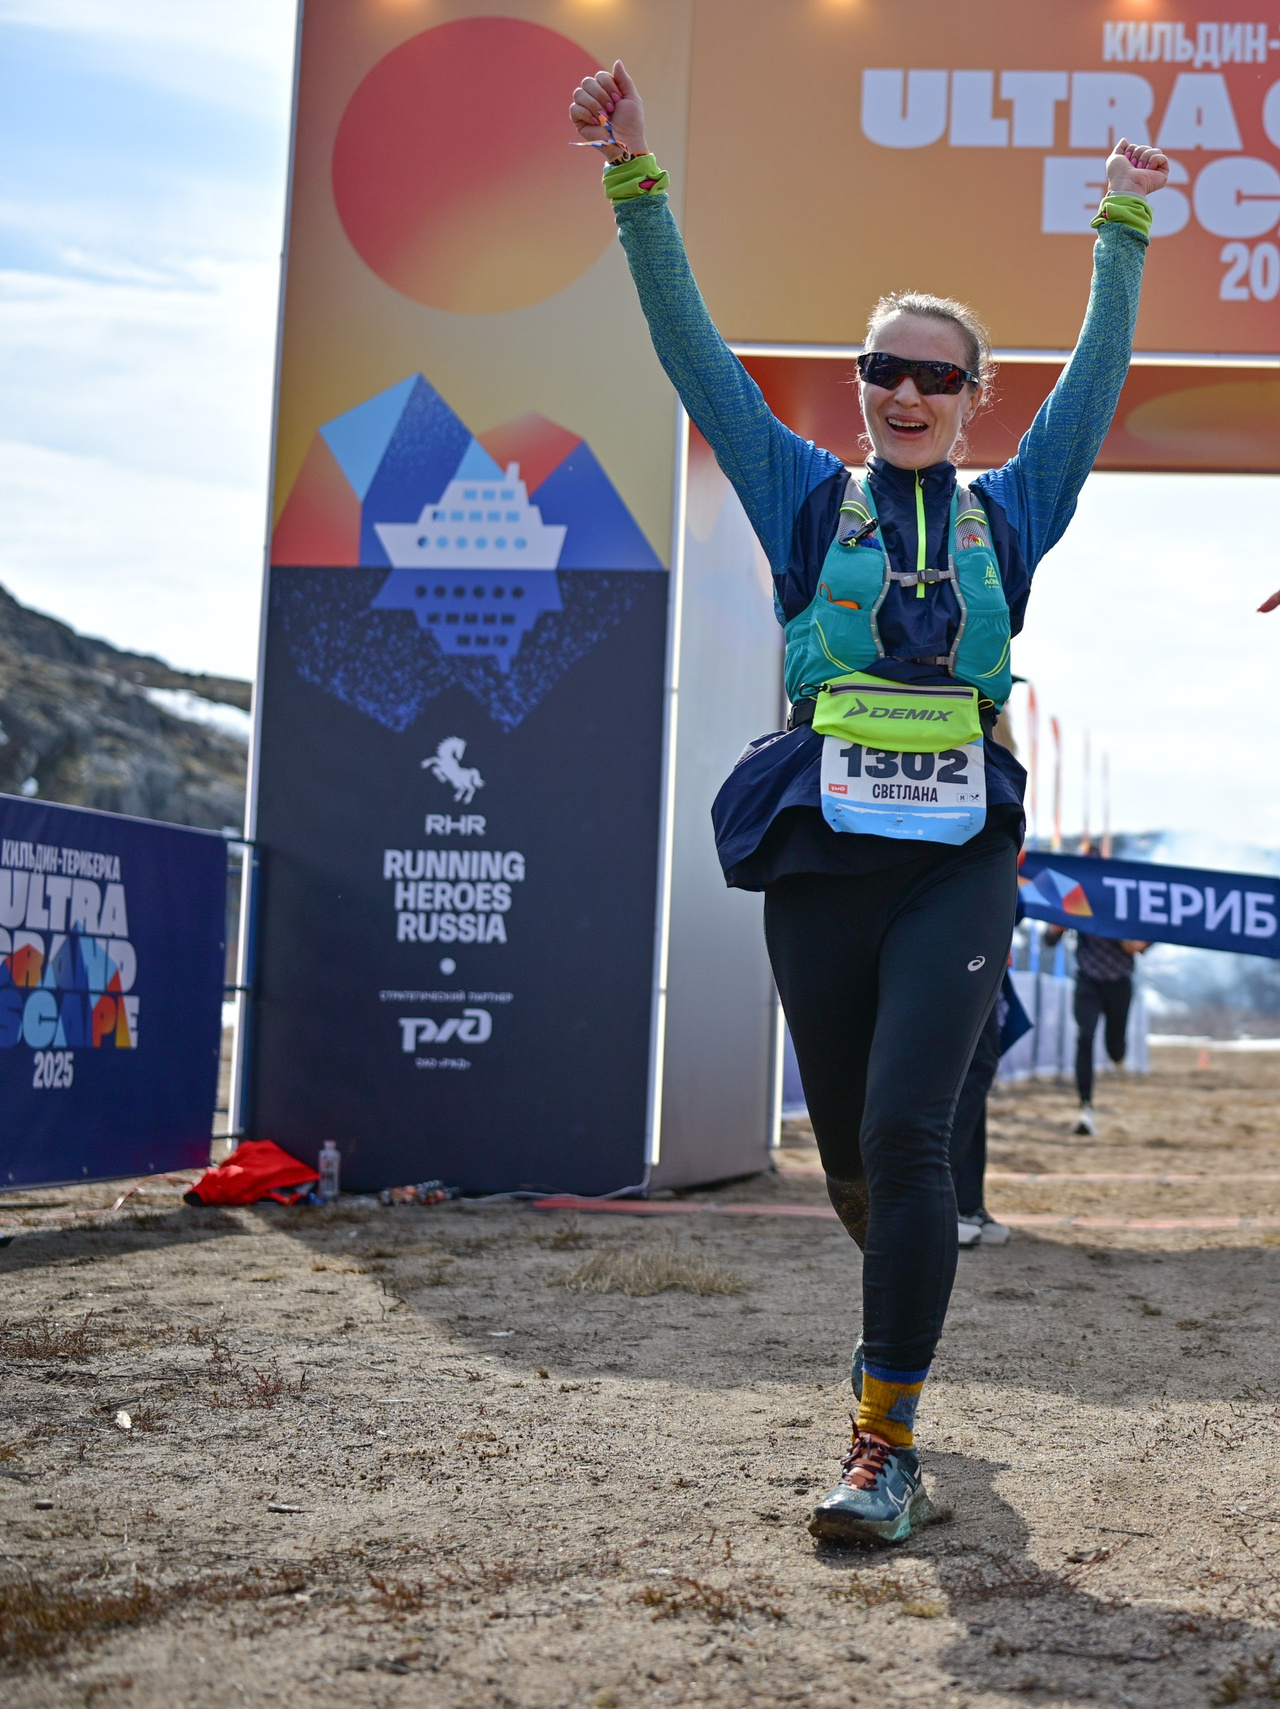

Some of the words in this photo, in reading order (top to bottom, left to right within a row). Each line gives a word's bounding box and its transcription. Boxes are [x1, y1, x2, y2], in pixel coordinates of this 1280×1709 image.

[860, 68, 1243, 152] ULTRA
[868, 707, 954, 722] DEMIX
[839, 743, 969, 785] 1302
[872, 783, 939, 803] СВЕТЛАНА
[425, 814, 486, 836] RHR
[2, 839, 121, 881] КИЛЬДИН-ТЕРИБЕРКА
[383, 849, 526, 882] RUNNING
[0, 868, 129, 938] ULTRA
[394, 881, 512, 912] HEROES
[397, 911, 507, 943] RUSSIA
[0, 988, 140, 1050] SCAPE
[33, 1050, 74, 1090] 2025
